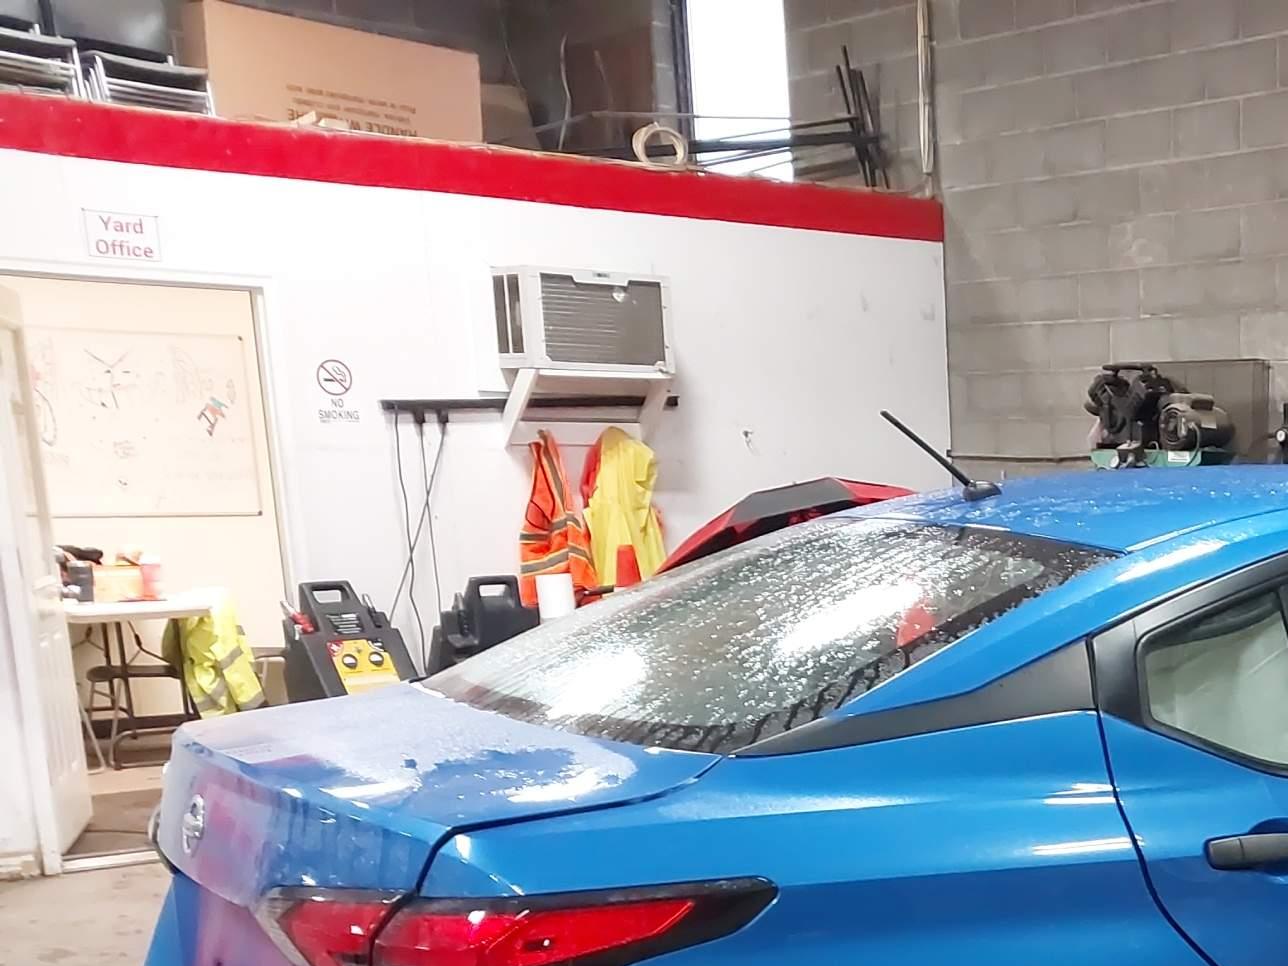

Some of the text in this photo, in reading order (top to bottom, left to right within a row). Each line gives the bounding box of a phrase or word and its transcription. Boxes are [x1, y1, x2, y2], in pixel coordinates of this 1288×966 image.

[98, 215, 144, 234] Yard
[96, 239, 154, 258] Office
[331, 398, 344, 408] NO
[319, 409, 360, 420] SMOKING
